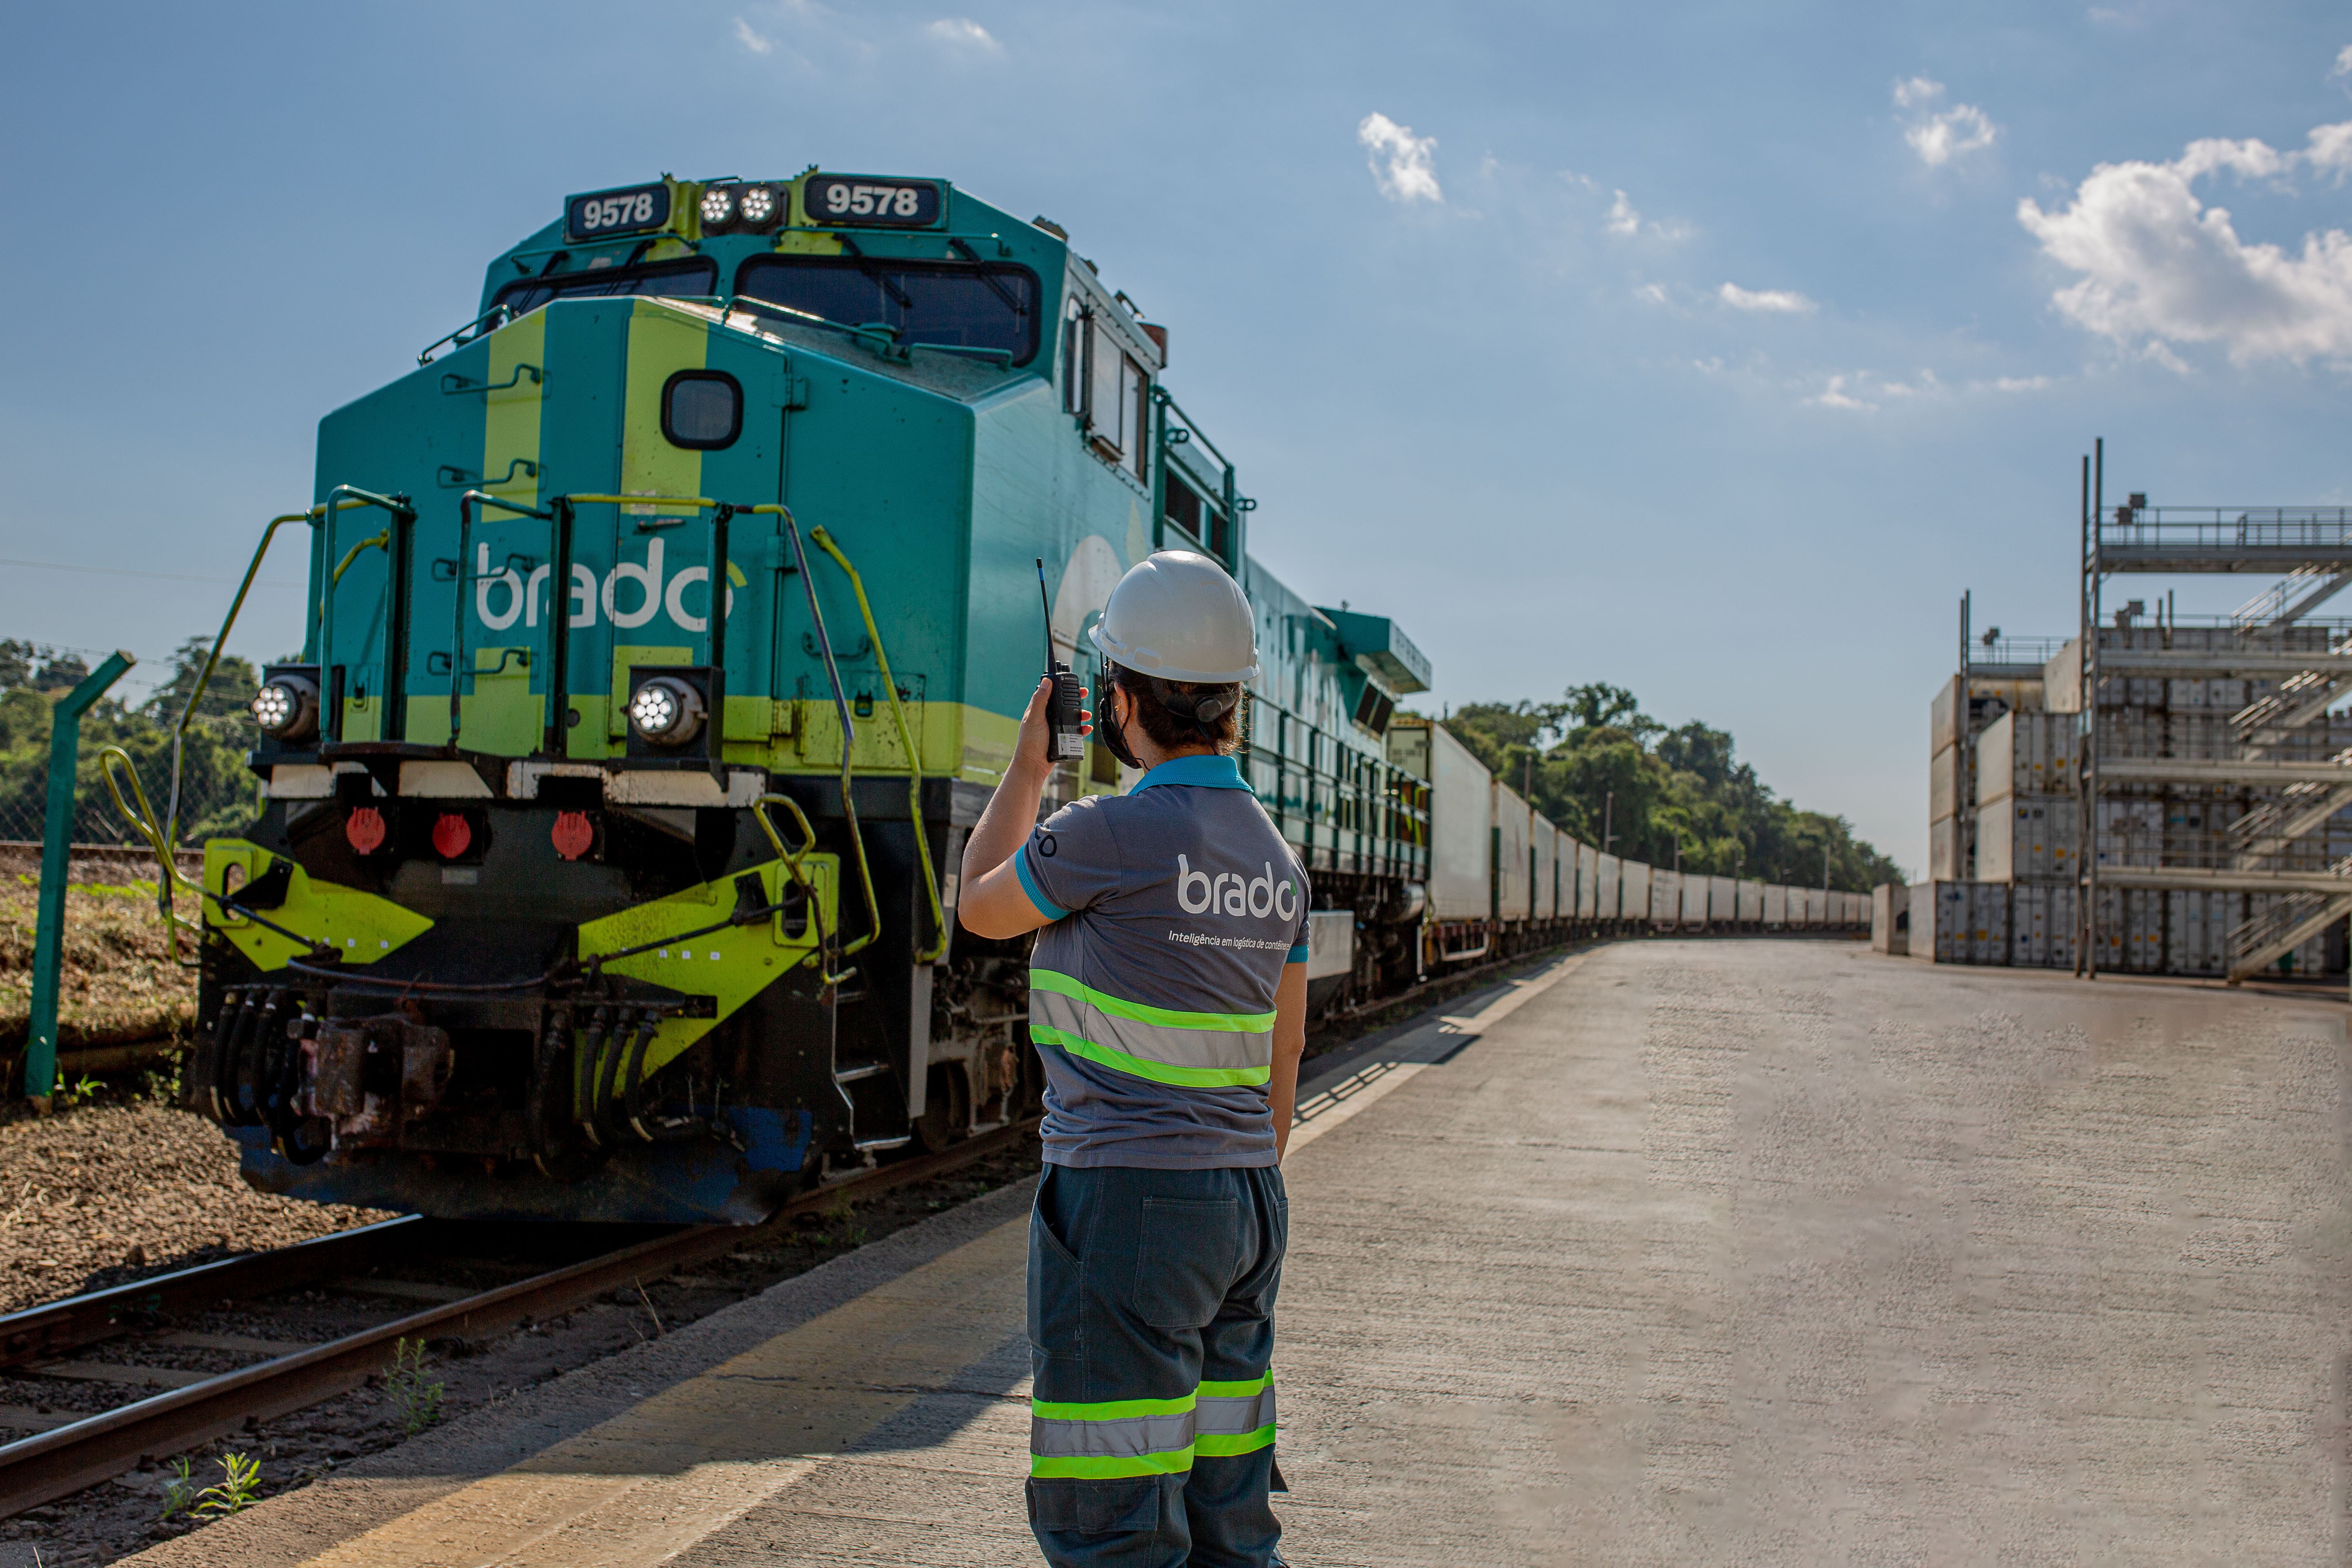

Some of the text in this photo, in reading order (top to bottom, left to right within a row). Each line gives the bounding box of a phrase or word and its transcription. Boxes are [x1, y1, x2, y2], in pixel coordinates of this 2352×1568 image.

[584, 193, 653, 229] 9578
[827, 184, 918, 216] 9578
[477, 537, 737, 632] brado
[1178, 854, 1296, 922] brado
[1168, 930, 1220, 946] Inteligência
[1221, 938, 1232, 947] em
[1233, 937, 1256, 950] logística
[1256, 938, 1264, 949] de
